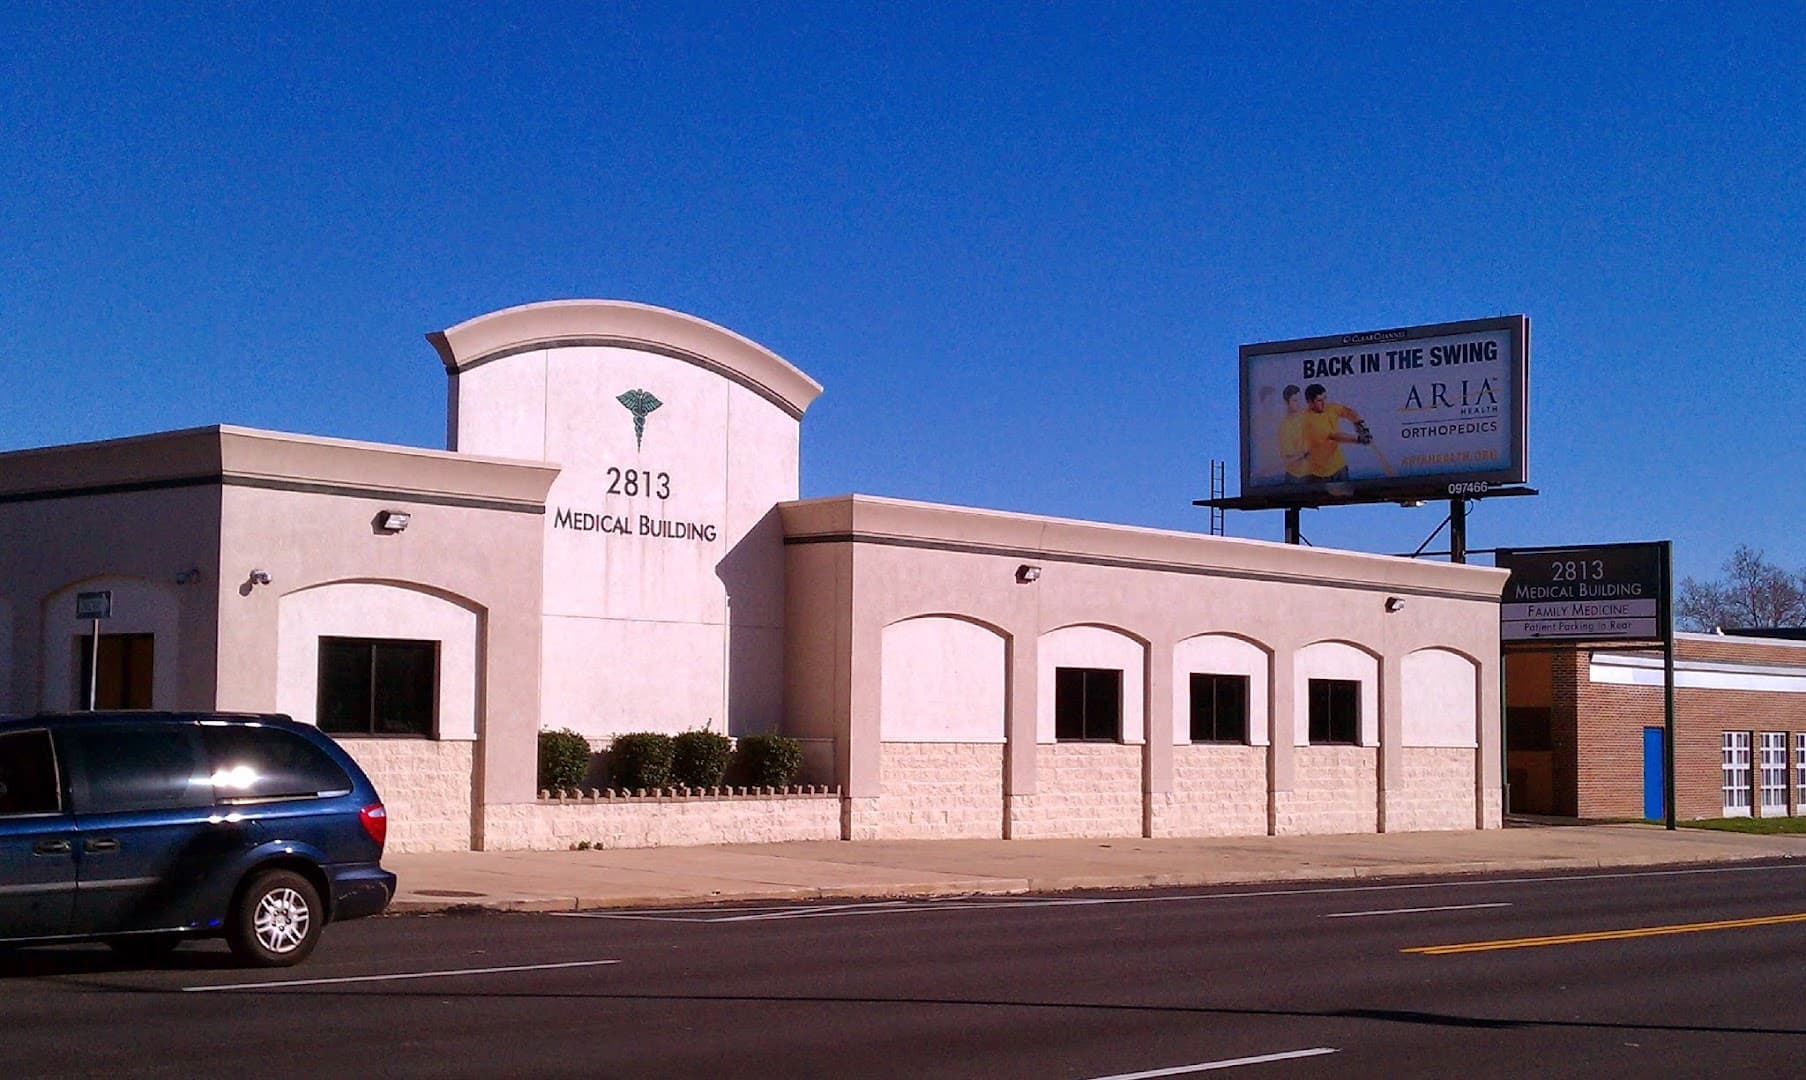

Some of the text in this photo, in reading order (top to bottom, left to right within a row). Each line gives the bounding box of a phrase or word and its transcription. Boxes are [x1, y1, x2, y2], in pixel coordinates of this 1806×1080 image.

[1303, 340, 1498, 379] BACK IN THE SWING
[1404, 377, 1498, 409] ARIA
[1460, 405, 1498, 415] HEALTH
[1401, 421, 1497, 439] ORTHOPEDICS
[606, 467, 670, 500] 2813
[1448, 481, 1488, 495] 097466
[554, 507, 717, 542] MEDICAL BUILDING
[1551, 560, 1604, 582] 2813
[1515, 583, 1642, 599] MEDICAL BUILDING
[1528, 604, 1630, 617] FAMILY MEDICINE
[1524, 622, 1556, 632] Patient
[1559, 620, 1593, 632] Parking
[1610, 621, 1632, 630] Rear
